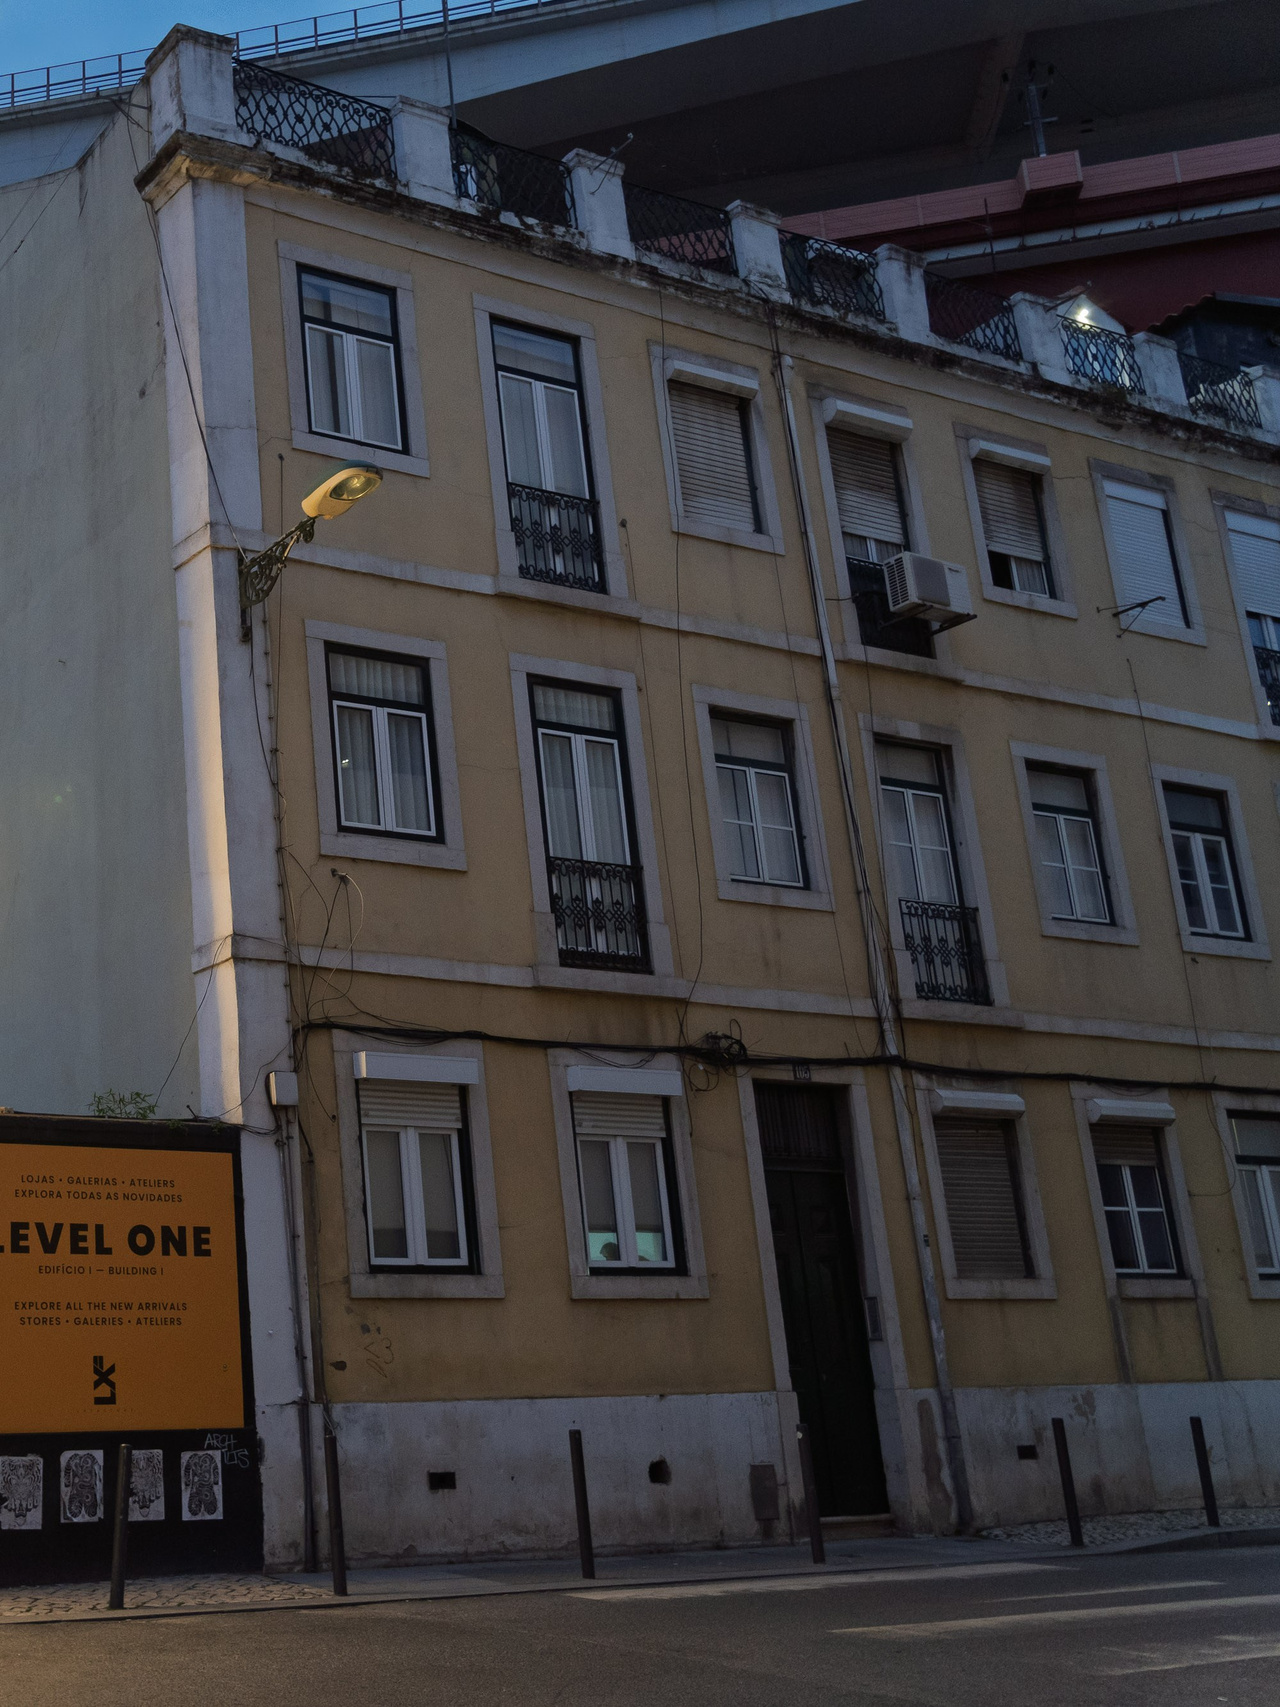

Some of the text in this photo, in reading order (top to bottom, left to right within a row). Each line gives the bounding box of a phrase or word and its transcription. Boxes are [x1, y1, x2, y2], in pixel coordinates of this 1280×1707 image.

[21, 1175, 175, 1188] LOJAS GALERIAS ATELIERS
[14, 1189, 183, 1202] EXPLORA TODAS AS NOVIDADES
[127, 1224, 212, 1257] ONE
[38, 1262, 85, 1275] EDIFÍCIO
[108, 1267, 157, 1276] BUILDING
[14, 1301, 188, 1311] EXPLORE ALL THE NEW ARRIVALS
[20, 1316, 182, 1326] STORES GALERIES ATELIERS
